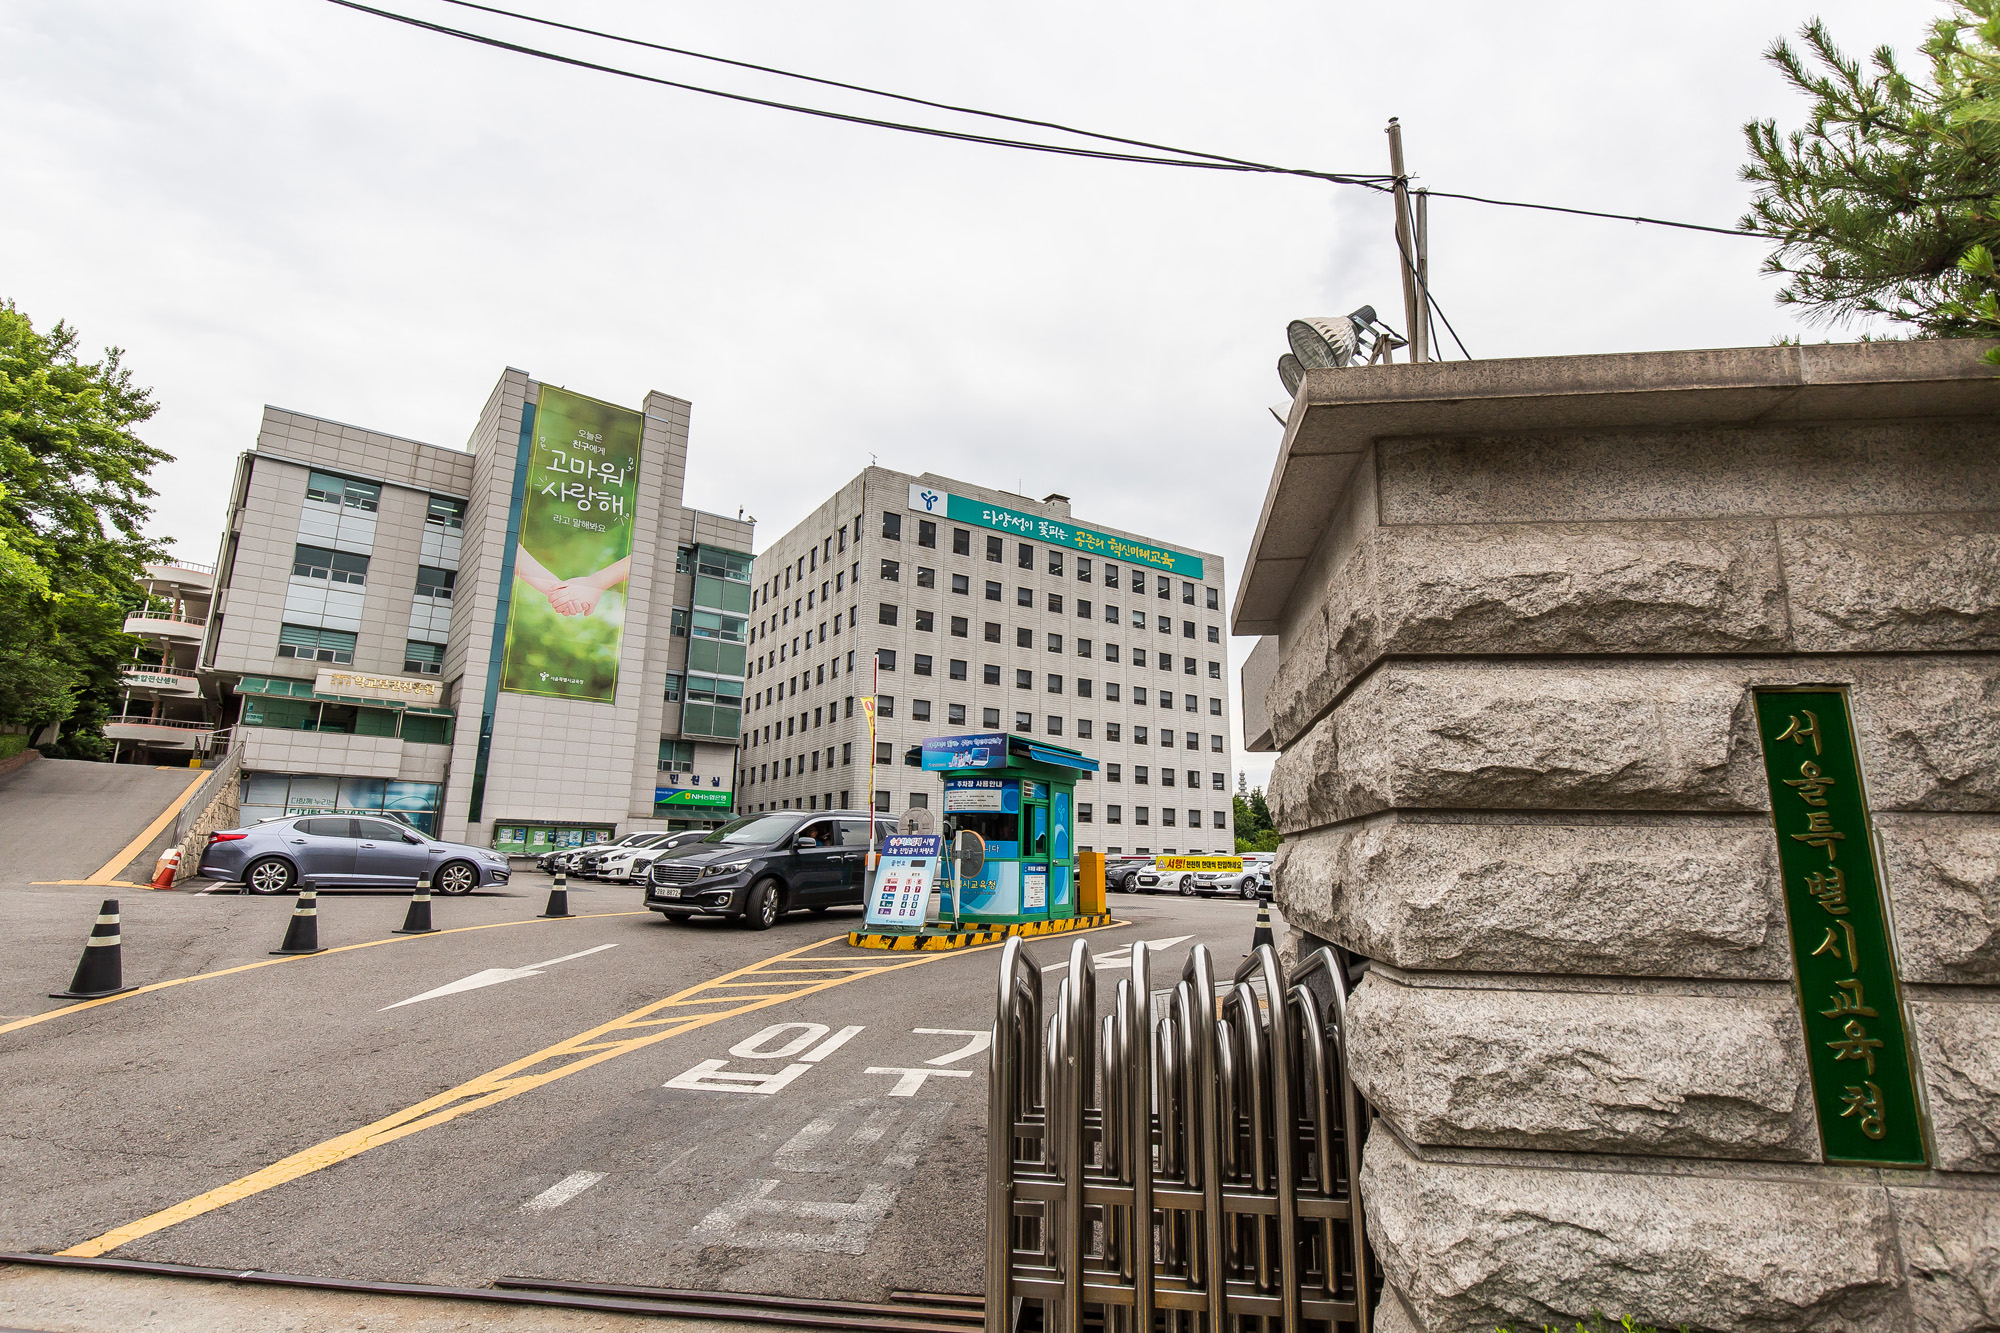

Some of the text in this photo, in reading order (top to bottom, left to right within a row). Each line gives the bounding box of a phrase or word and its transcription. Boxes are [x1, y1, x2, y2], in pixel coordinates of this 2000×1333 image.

[578, 429, 603, 443] 오늘은
[572, 440, 606, 456] 친구에게
[545, 449, 625, 488] 고마워
[541, 481, 624, 516] 사랑해
[553, 514, 606, 533] 라고 말해봐요
[982, 509, 1176, 569] 다양성이 꽃피는 공존의 혁신미래교육
[128, 674, 179, 686] 통합전산센터
[354, 675, 435, 695] 학교보건진흥원
[669, 773, 721, 788] 민원실
[957, 780, 974, 788] 주차장
[691, 793, 727, 802] NH농협은행
[922, 837, 936, 847] 시행
[887, 847, 935, 855] 오늘 진입금지 차량은
[1166, 858, 1186, 869] 서행!
[1186, 860, 1201, 869] 천천히
[1217, 860, 1242, 870] 진입하세요
[942, 879, 996, 890] 서울시교육청
[1775, 709, 1887, 1141] 서울특별시교육청
[663, 1022, 994, 1097] 입구
